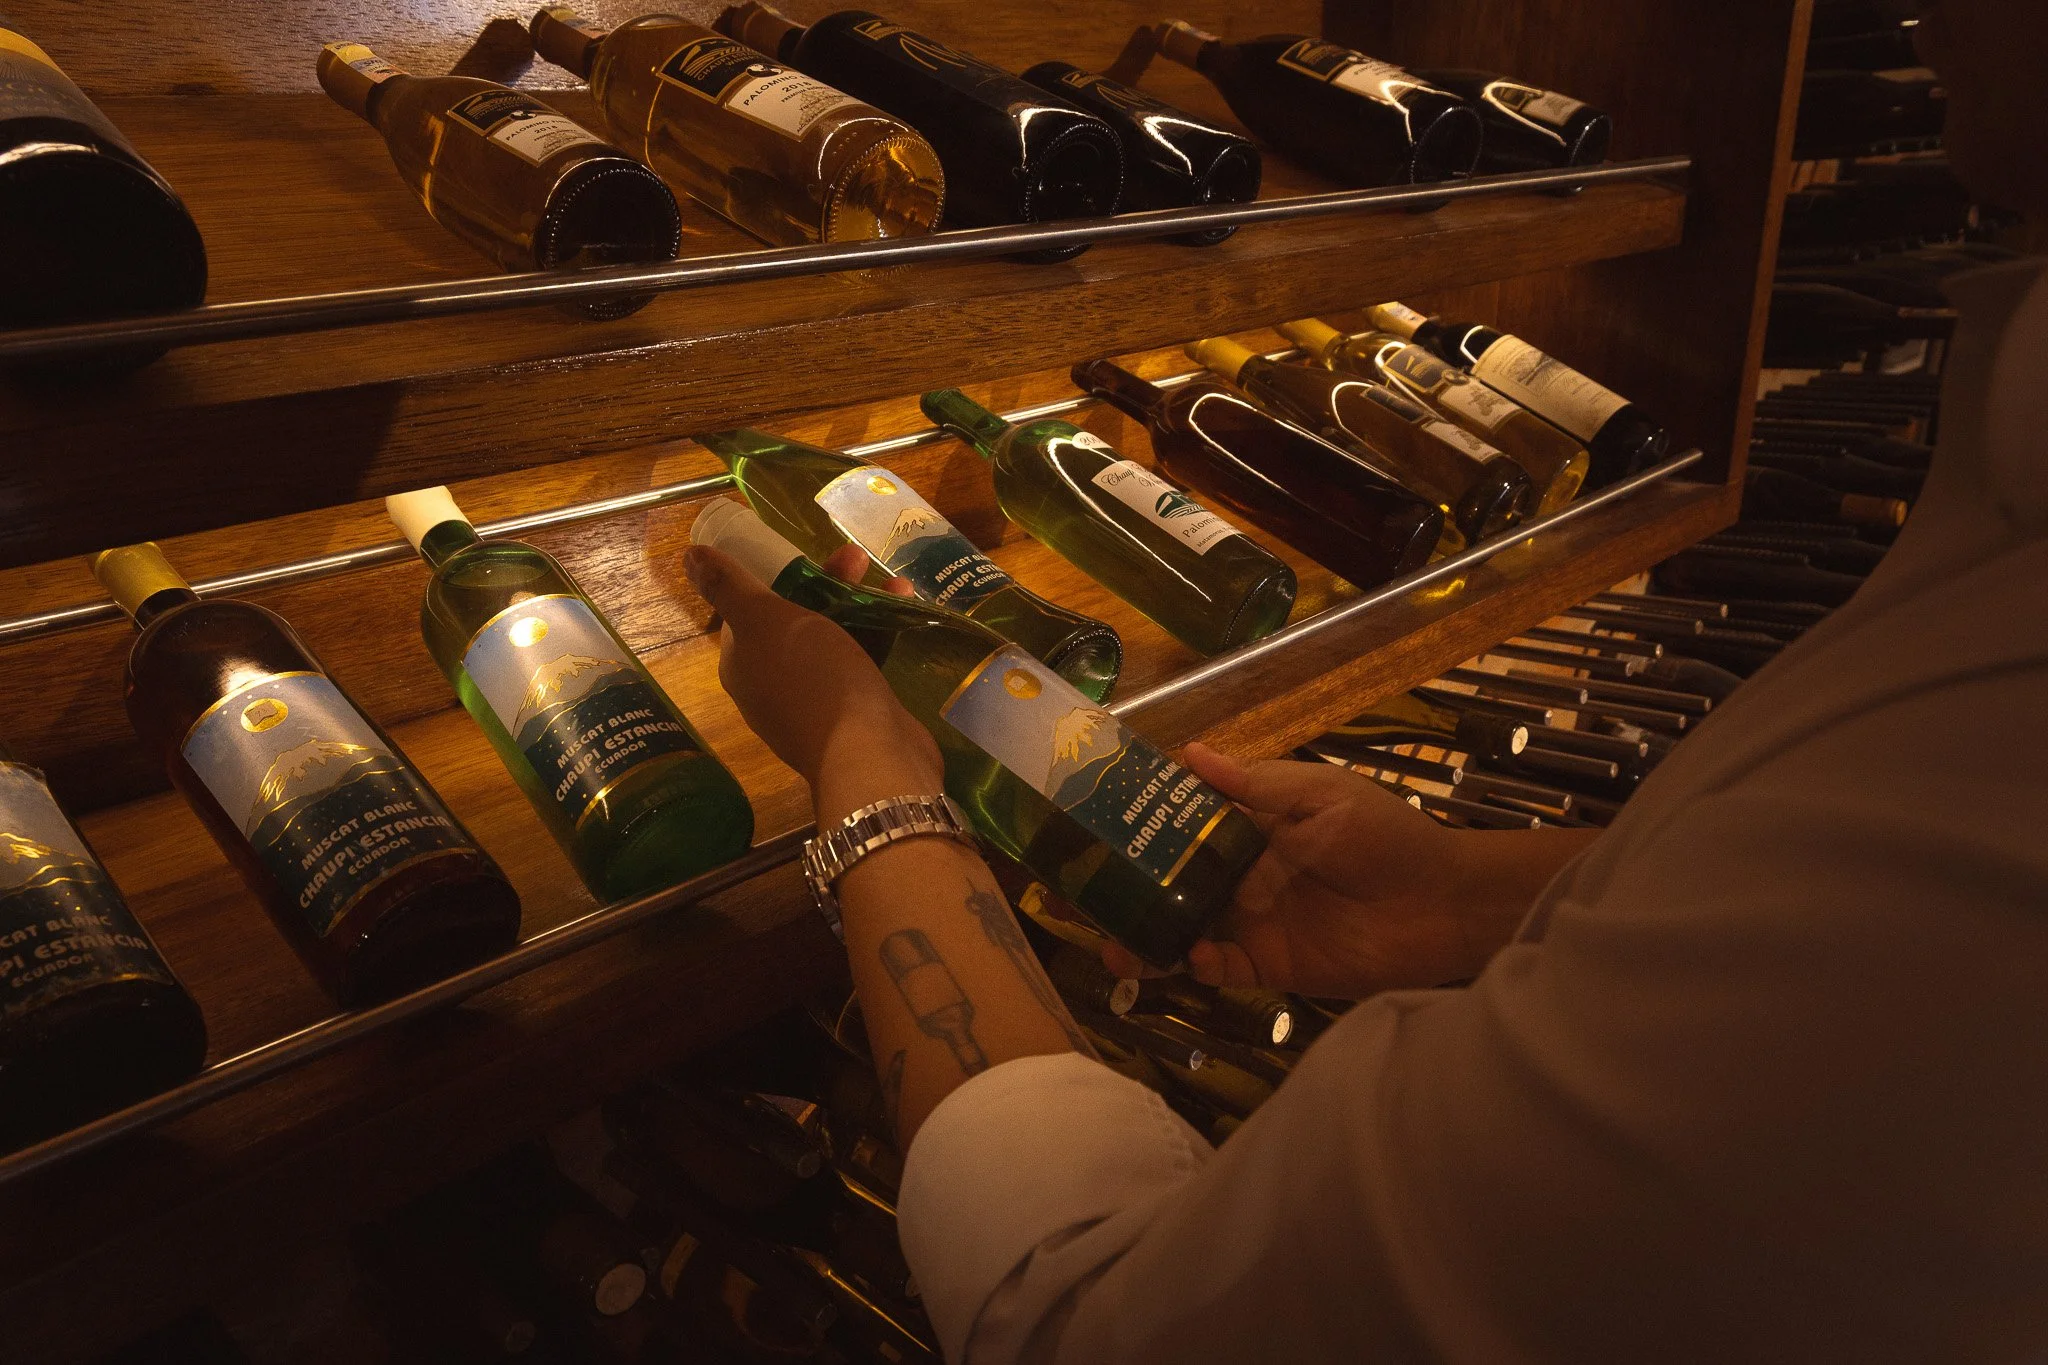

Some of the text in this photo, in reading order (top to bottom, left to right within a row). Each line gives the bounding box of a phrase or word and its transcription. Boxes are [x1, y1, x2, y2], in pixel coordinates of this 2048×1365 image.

[743, 75, 798, 106] PALOMINO
[506, 120, 549, 141] PALOMINO
[1101, 468, 1136, 486] Chaup
[934, 556, 973, 583] MUSCAT
[935, 571, 976, 606] CHAUPI
[557, 708, 654, 769] MUSCAT BLANC
[555, 721, 683, 802] CHAUPI ESTANCIA
[594, 740, 647, 774] ECUADOR
[1122, 778, 1162, 825] MUSCAT
[1173, 793, 1206, 828] ECUADOR
[301, 800, 418, 871] MUSCAT BLANC
[1126, 803, 1174, 858] CHAUPI
[299, 815, 452, 909] CHAUPI ESTANCIA
[348, 836, 410, 875] ECUADOR
[0, 915, 113, 948] CAT BLANC
[34, 933, 149, 960] ESTANCIA
[11, 952, 94, 988] ECUADOR
